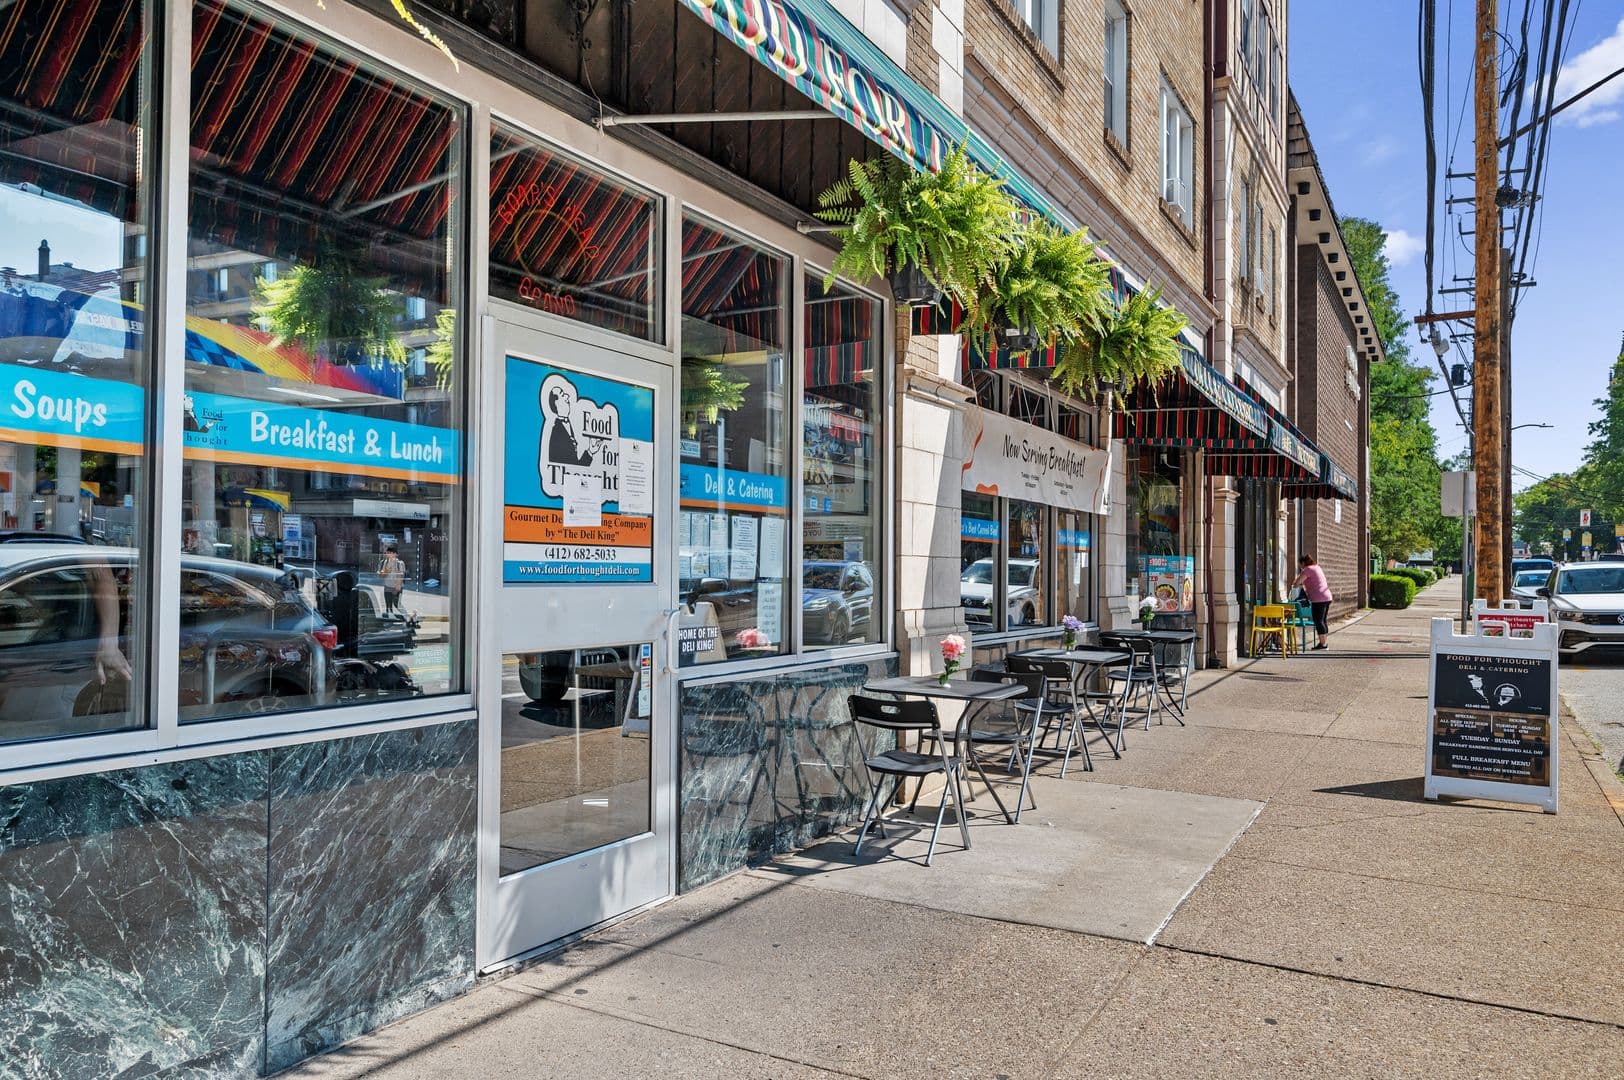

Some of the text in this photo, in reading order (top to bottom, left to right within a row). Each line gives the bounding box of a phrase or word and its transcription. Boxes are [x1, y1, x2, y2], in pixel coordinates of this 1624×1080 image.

[820, 37, 915, 168] FOR
[10, 379, 107, 432] Soups
[202, 408, 223, 419] Food
[582, 410, 612, 436] Food
[185, 432, 228, 445] hought
[250, 411, 442, 464] Breakfast & Lunch
[602, 444, 619, 466] for
[1003, 434, 1085, 478] Now Serving Breakfast!
[705, 473, 723, 495] Deli
[727, 477, 735, 496] &
[739, 478, 774, 504] Catering
[510, 510, 549, 523] Gourmet
[614, 518, 647, 531] Company
[545, 528, 555, 540] by
[580, 530, 595, 539] Deli
[545, 547, 617, 560] (412) 682-5033
[519, 565, 640, 576] www.foodforthoughtdeli.com
[679, 627, 718, 640] HOME OF THE
[682, 640, 715, 652] DELI KING!
[1496, 657, 1543, 666] THOUGHT
[1460, 735, 1489, 743] TUESDAY
[1470, 756, 1510, 765] BREAKFAST
